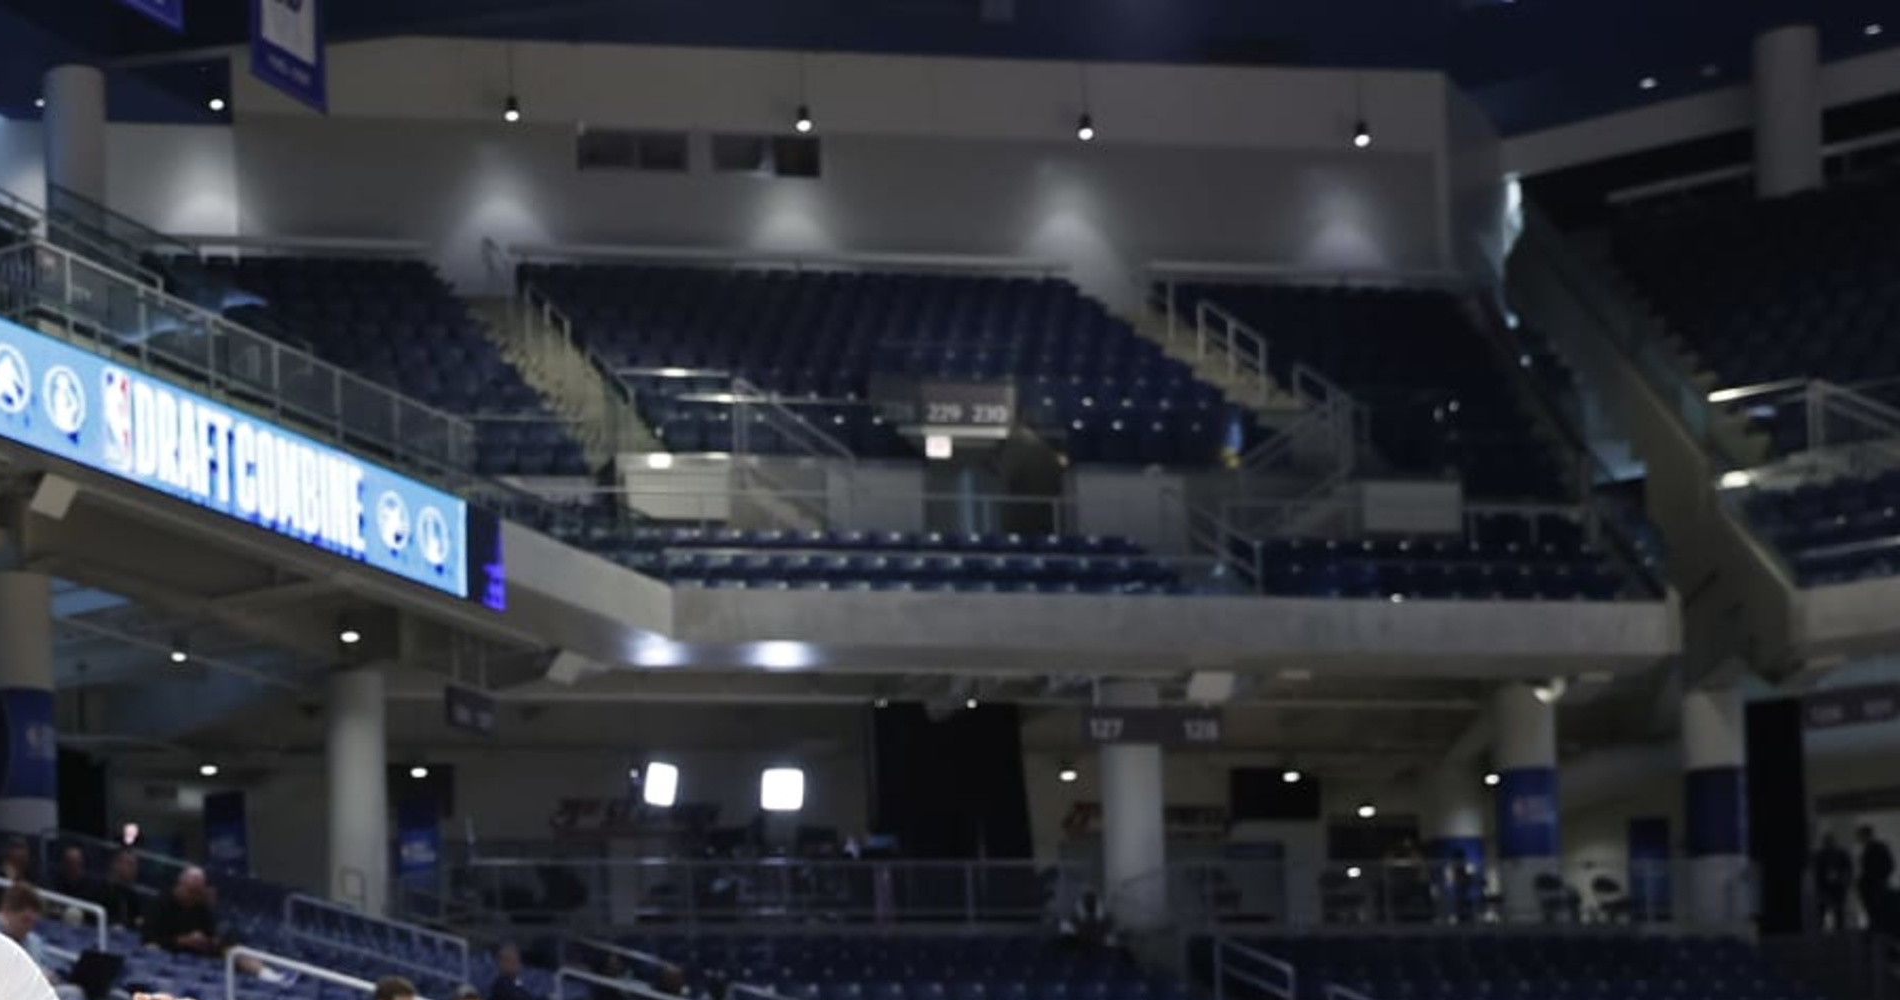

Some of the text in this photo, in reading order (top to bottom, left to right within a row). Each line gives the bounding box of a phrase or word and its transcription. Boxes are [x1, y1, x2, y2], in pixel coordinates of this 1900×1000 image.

[133, 380, 365, 551] DRAFT COMBINE
[1090, 718, 1125, 742] 127
